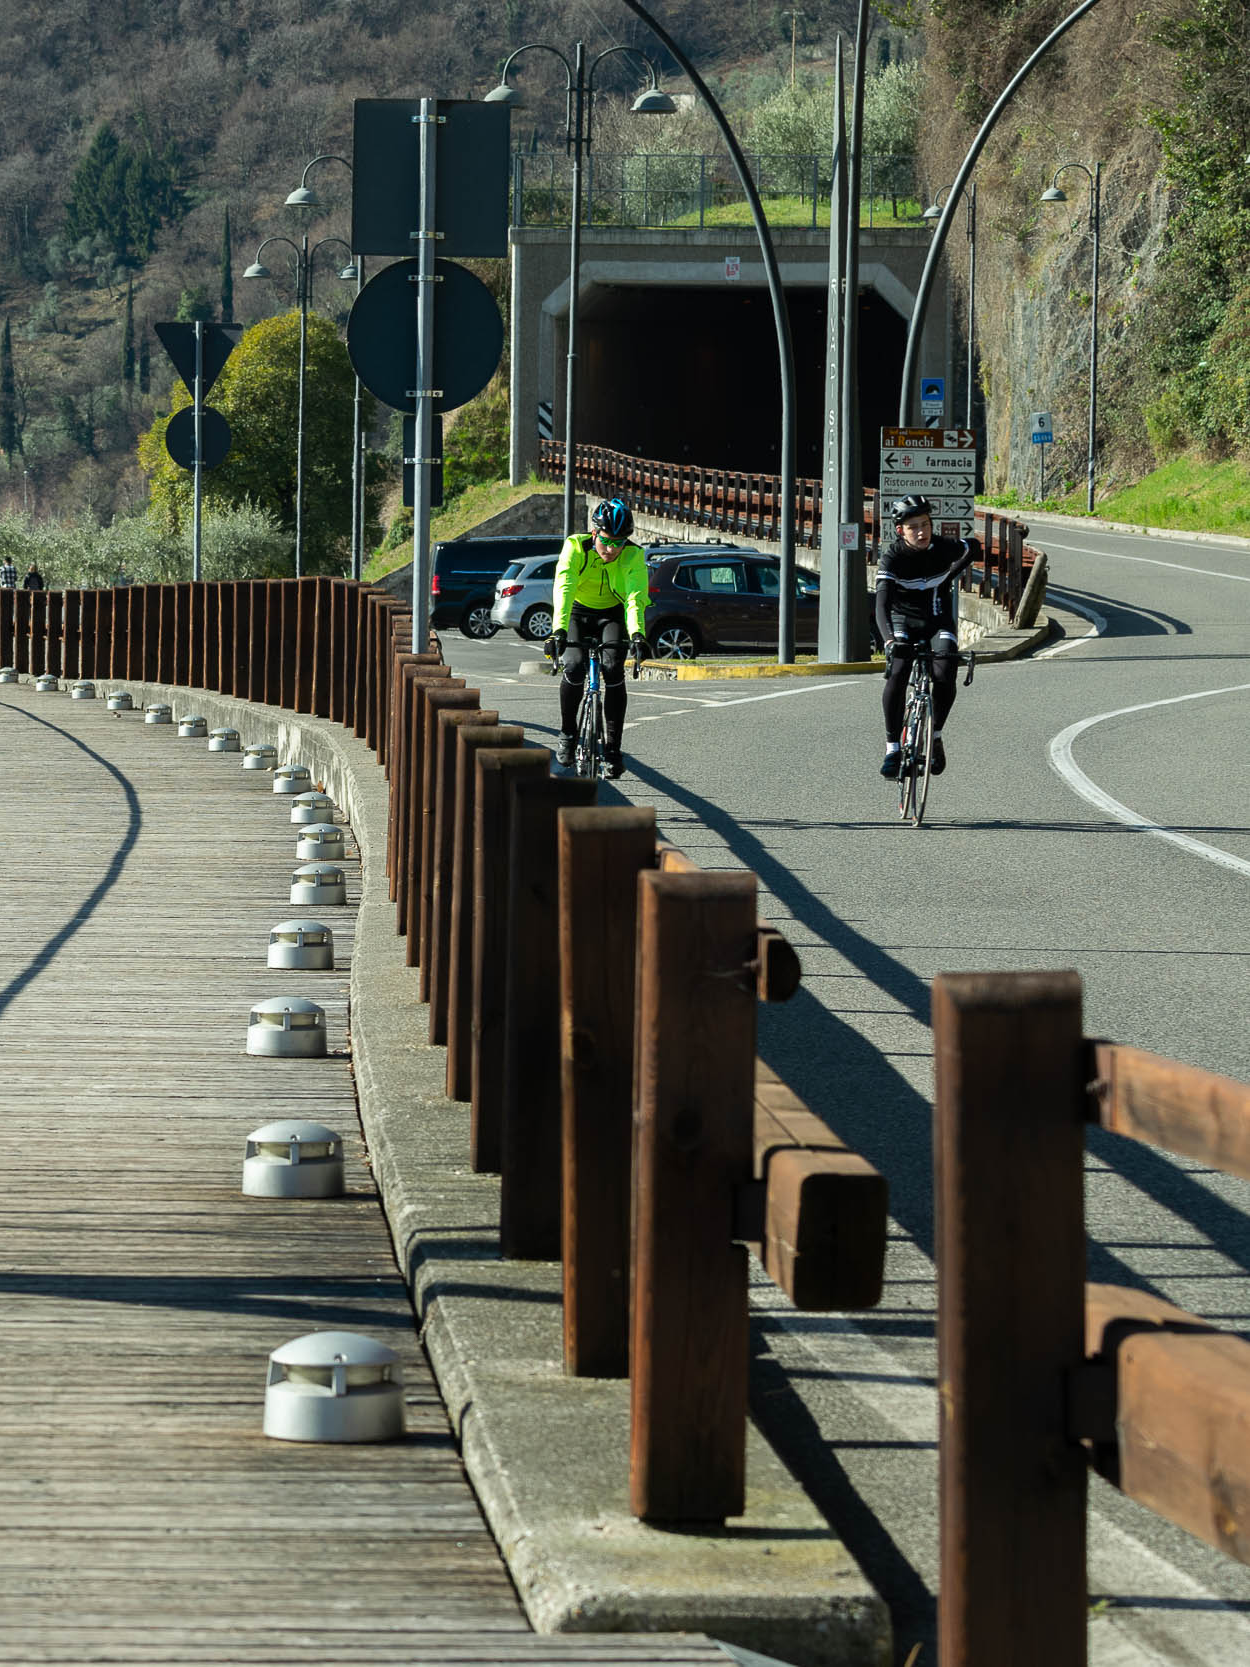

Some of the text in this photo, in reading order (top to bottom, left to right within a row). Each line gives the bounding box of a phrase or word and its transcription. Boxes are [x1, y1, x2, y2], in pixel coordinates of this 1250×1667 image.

[830, 363, 836, 398] DI
[1038, 417, 1045, 428] 6
[885, 435, 934, 447] ai Ronchi
[827, 409, 836, 503] SOLTO
[926, 456, 972, 468] farmacia
[884, 476, 929, 487] Ristorante
